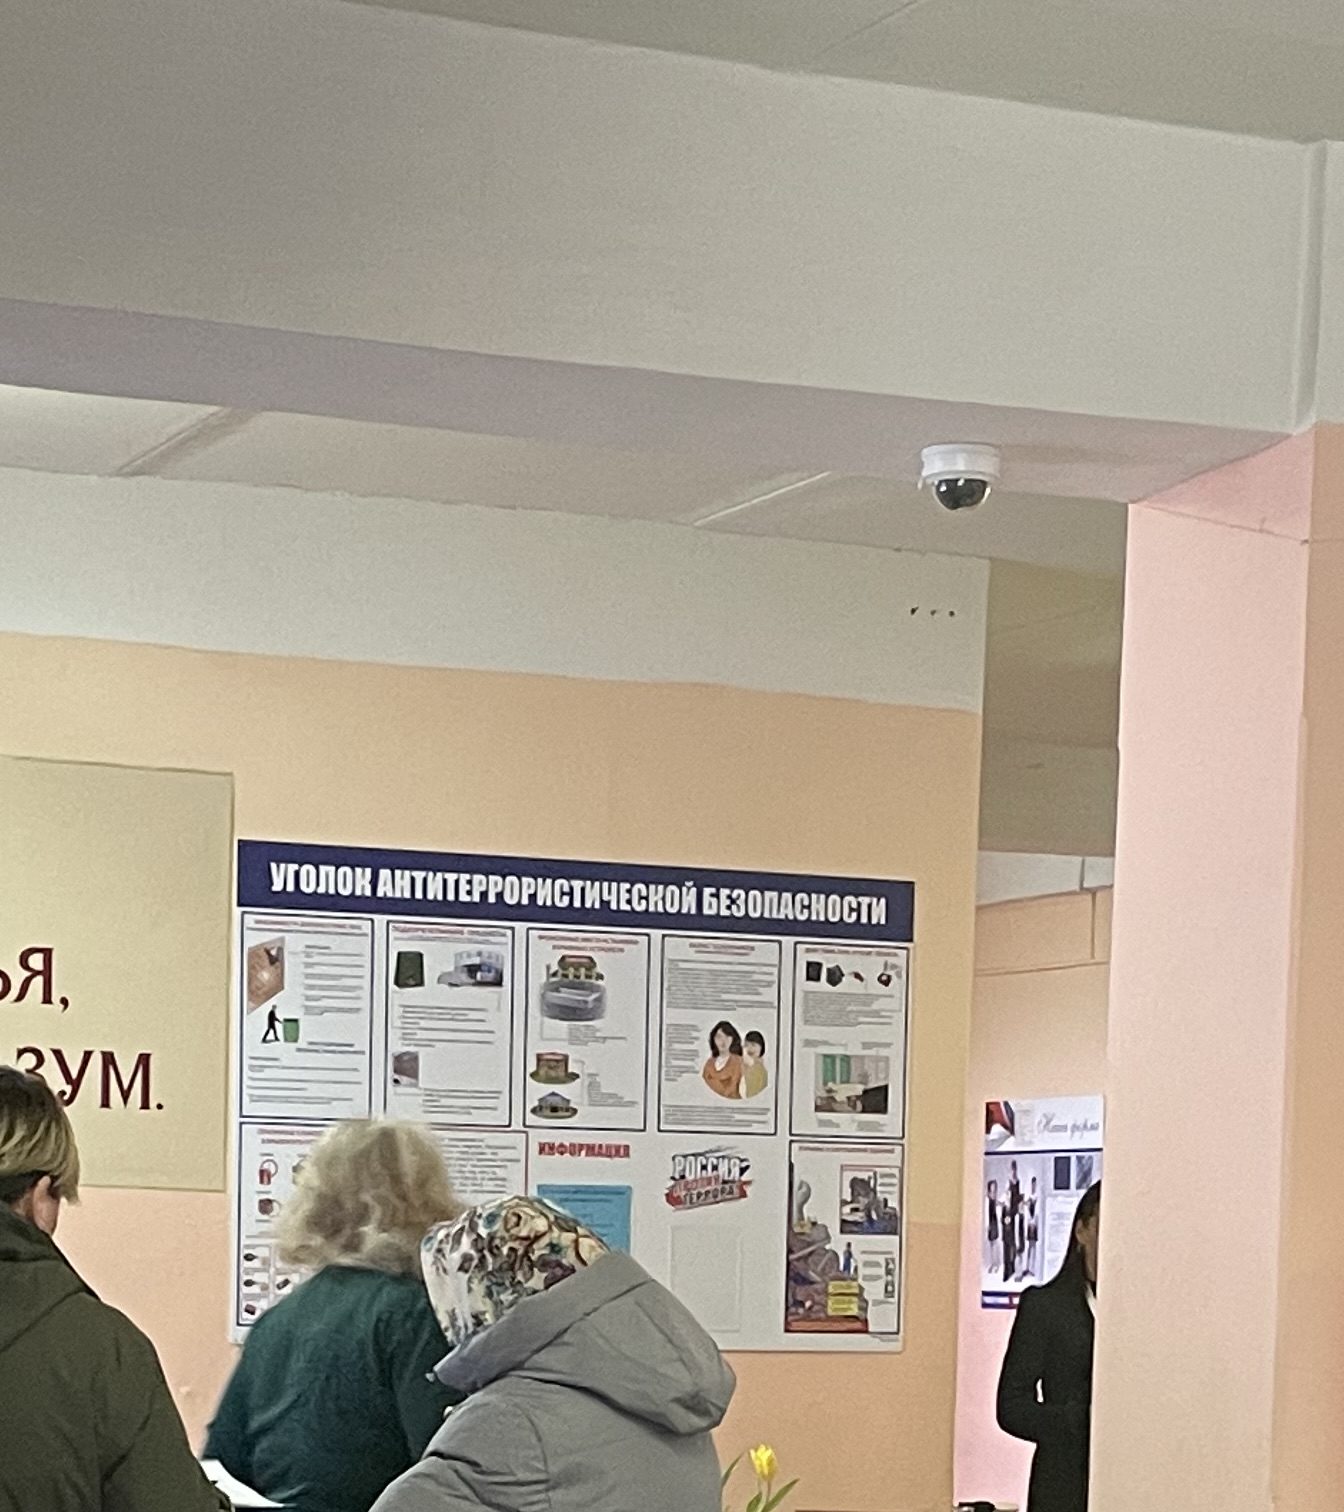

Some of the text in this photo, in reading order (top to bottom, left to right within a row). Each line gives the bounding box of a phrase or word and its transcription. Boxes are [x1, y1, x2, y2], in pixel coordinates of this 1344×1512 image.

[270, 861, 887, 925] УГОЛОК АНТИТЕРРОРИСТИЧЕСКОЙ БЕЗОПАСНОСТИ
[538, 1141, 631, 1160] ИНФОРМАЦИЯ
[674, 1155, 741, 1181] РОССИЯ
